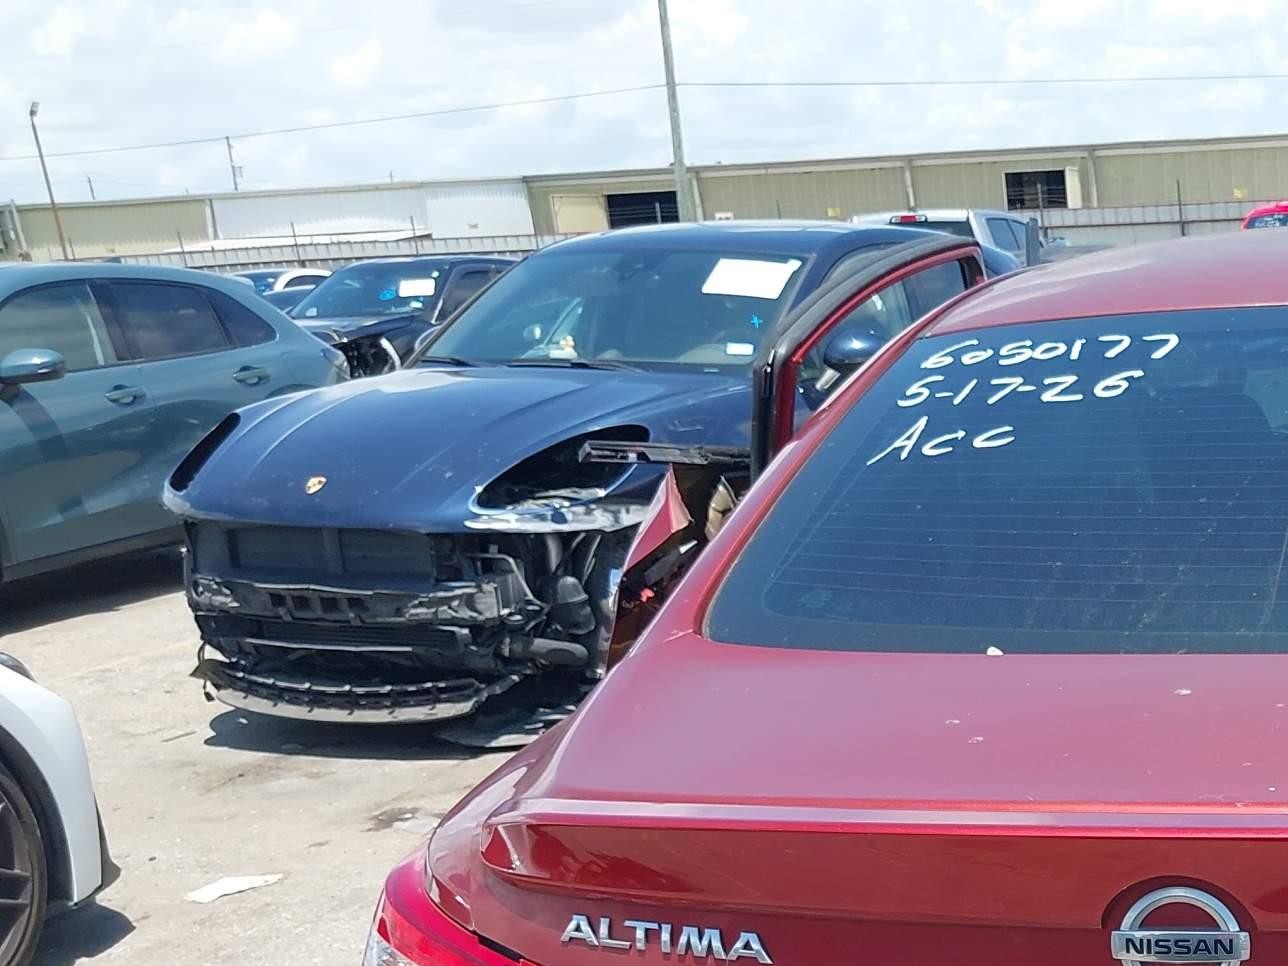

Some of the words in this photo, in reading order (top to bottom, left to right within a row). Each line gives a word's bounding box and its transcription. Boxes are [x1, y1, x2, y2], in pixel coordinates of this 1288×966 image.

[897, 369, 1145, 407] 5-17-26
[560, 914, 774, 965] ALTIMA
[1125, 938, 1234, 955] NISSAN
